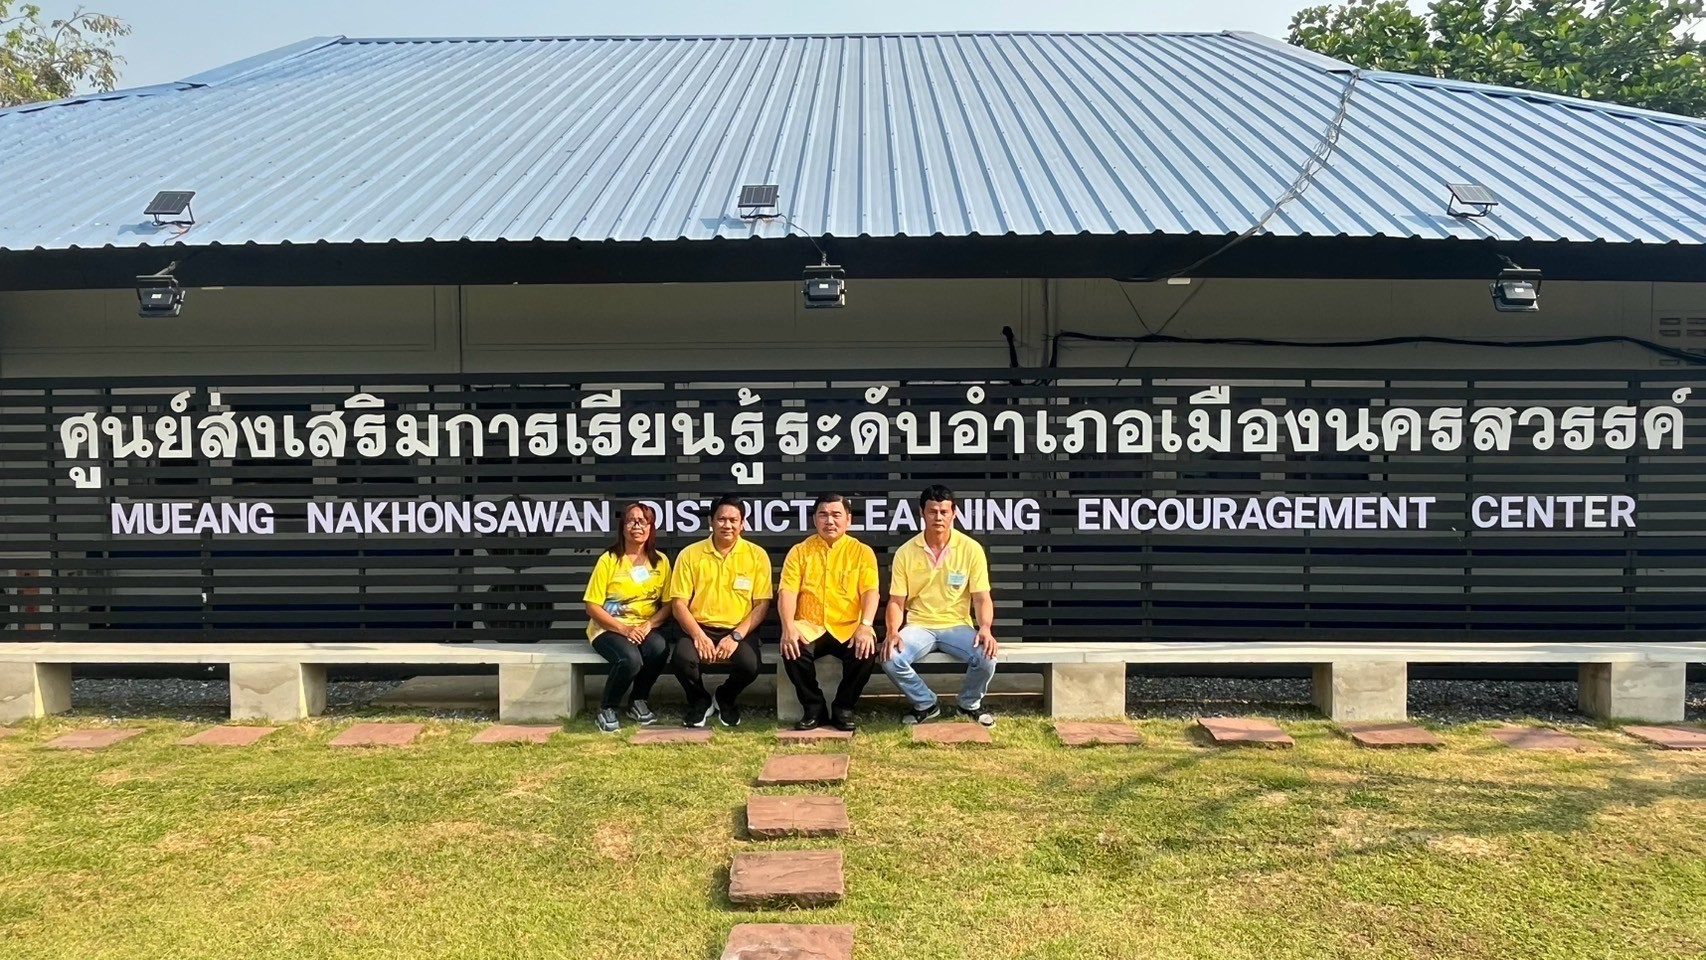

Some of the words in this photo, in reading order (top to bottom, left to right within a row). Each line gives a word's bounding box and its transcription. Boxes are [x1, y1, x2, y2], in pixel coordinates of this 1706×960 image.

[60, 385, 1692, 489] ศูนย์ส่งเสริมการเรียนรู้ระดับอำเภอเมืองนครสวรรค์
[111, 502, 274, 535] MUEANG
[307, 500, 610, 534] NAKHONSAWAN
[844, 498, 1040, 532] EANING
[1078, 496, 1436, 531] ENCOURAGEMENT
[1471, 495, 1636, 529] CENTER
